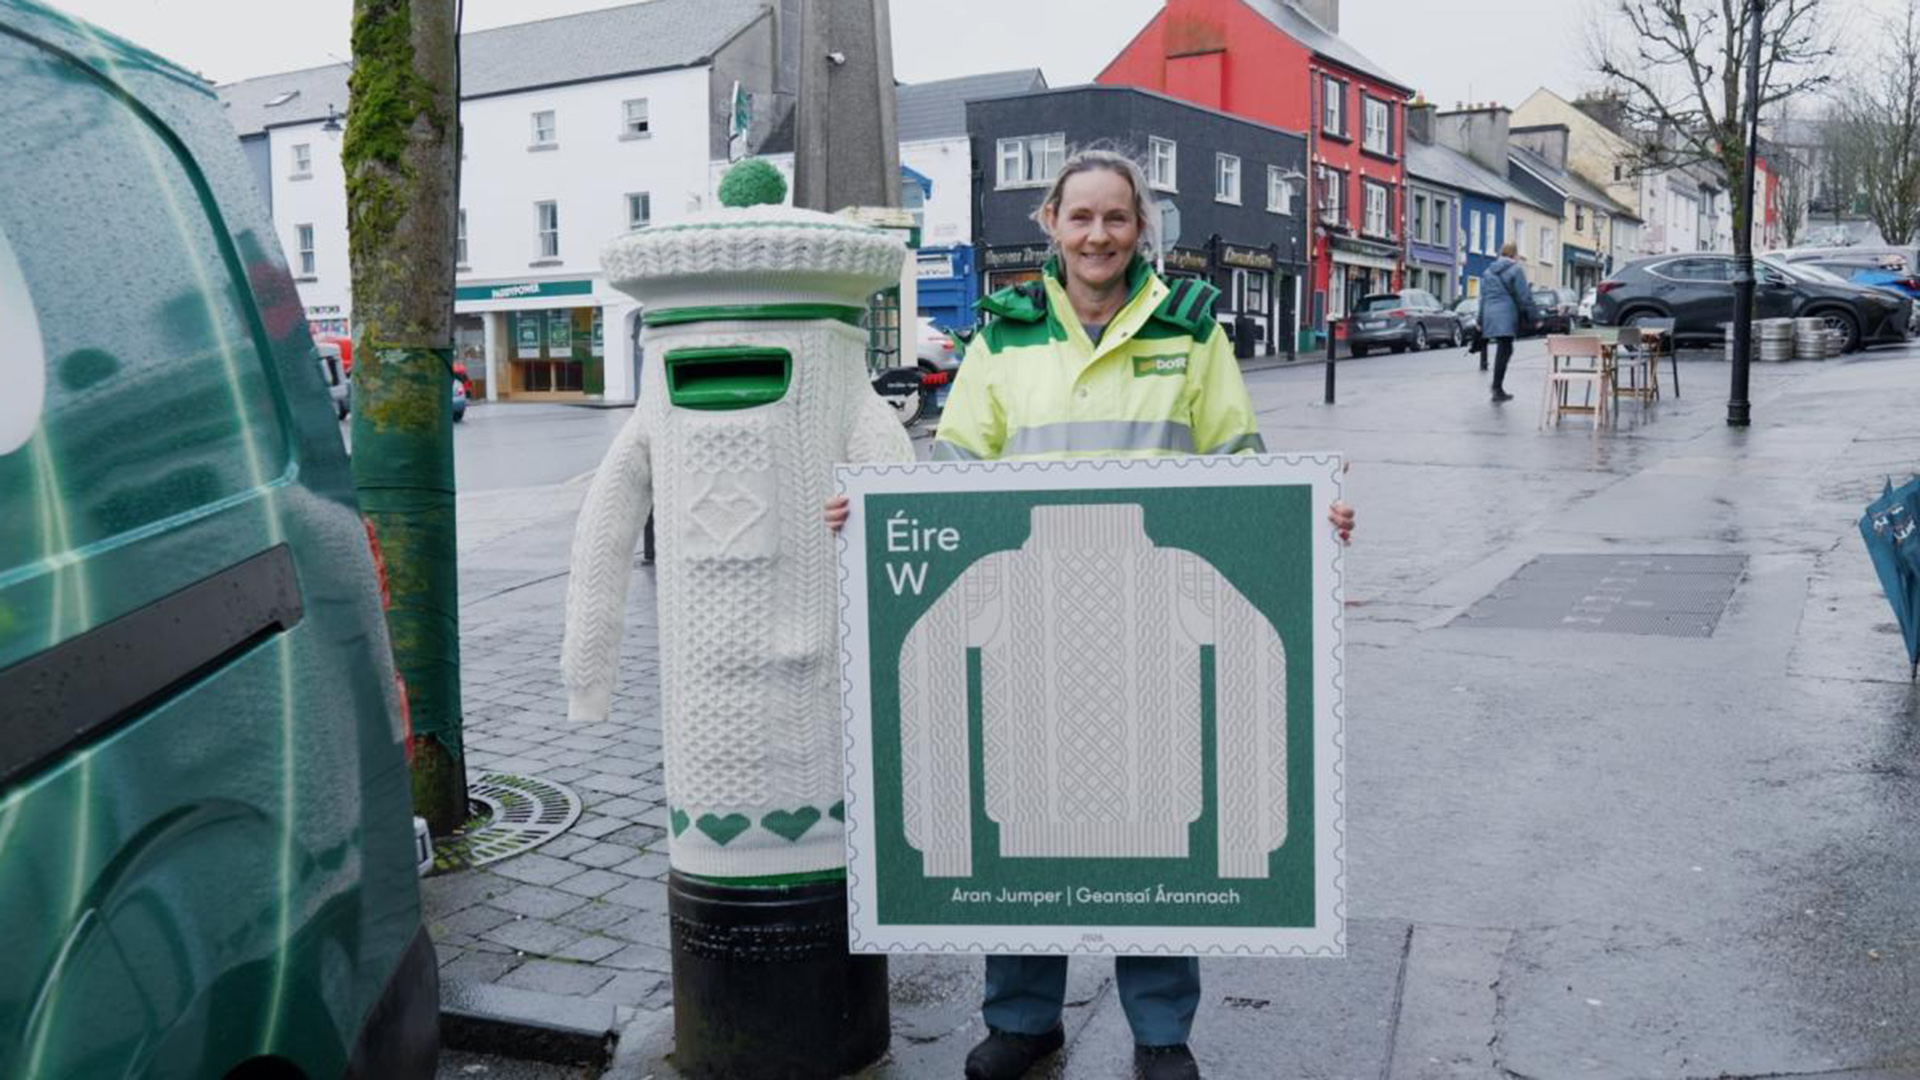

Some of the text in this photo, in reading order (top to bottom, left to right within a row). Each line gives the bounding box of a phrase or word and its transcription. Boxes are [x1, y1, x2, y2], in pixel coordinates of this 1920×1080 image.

[886, 509, 960, 552] Éire
[885, 562, 929, 596] W
[952, 887, 991, 902] Aran
[996, 888, 1062, 906] Jumper
[1075, 887, 1150, 903] Geansaí
[1154, 884, 1240, 904] Árannach
